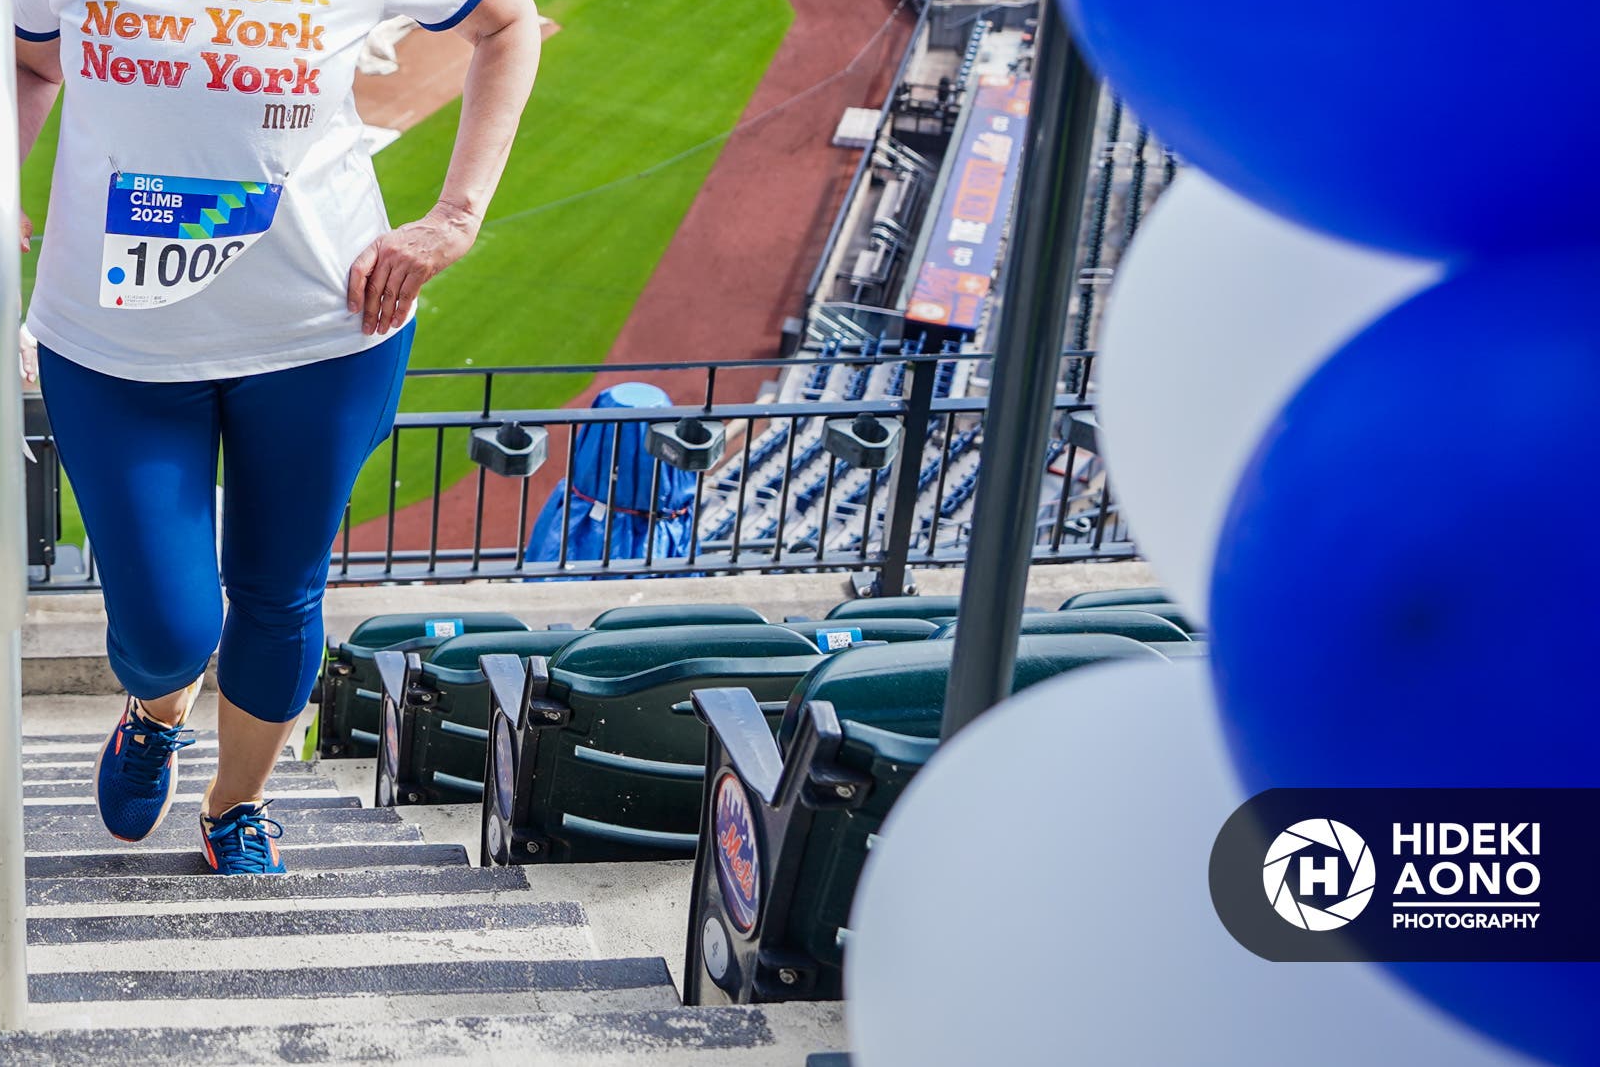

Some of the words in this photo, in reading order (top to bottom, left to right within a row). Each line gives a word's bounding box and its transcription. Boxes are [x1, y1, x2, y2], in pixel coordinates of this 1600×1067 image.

[80, 0, 196, 43] New
[204, 7, 326, 51] York
[80, 40, 191, 88] New
[199, 51, 321, 96] York
[130, 192, 183, 208] CLIMB
[133, 176, 164, 192] BIG
[130, 208, 174, 223] 2025
[721, 822, 753, 901] Mets
